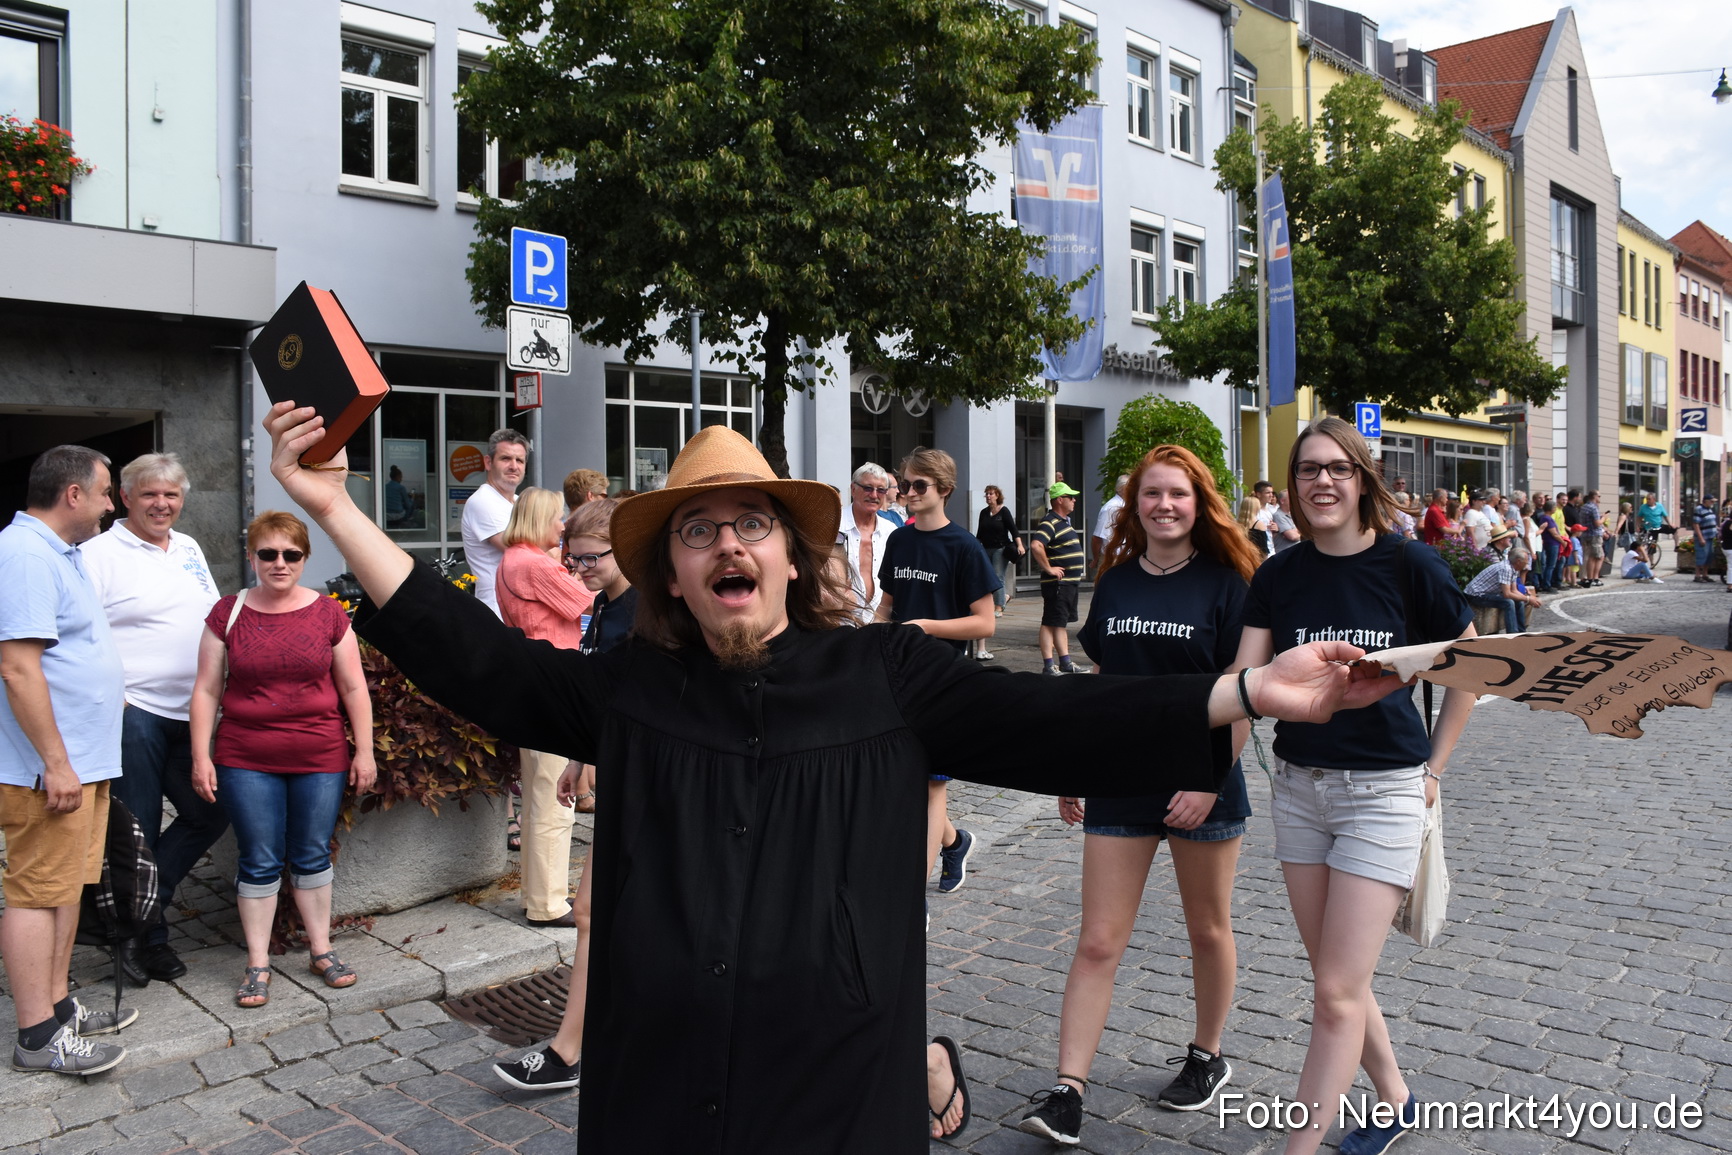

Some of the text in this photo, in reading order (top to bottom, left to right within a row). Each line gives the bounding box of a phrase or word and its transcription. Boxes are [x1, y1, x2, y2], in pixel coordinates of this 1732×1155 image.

[525, 240, 555, 295] P
[530, 317, 551, 329] nur
[1361, 407, 1376, 434] P
[893, 566, 939, 583] Luthraner
[1106, 616, 1195, 640] Lutheraner
[1295, 626, 1394, 648] Lutheraner
[1511, 636, 1656, 704] THESEN
[1607, 681, 1635, 696] die
[1626, 645, 1715, 683] Erlösung
[1633, 697, 1667, 718] dem
[1662, 666, 1725, 700] Glauben
